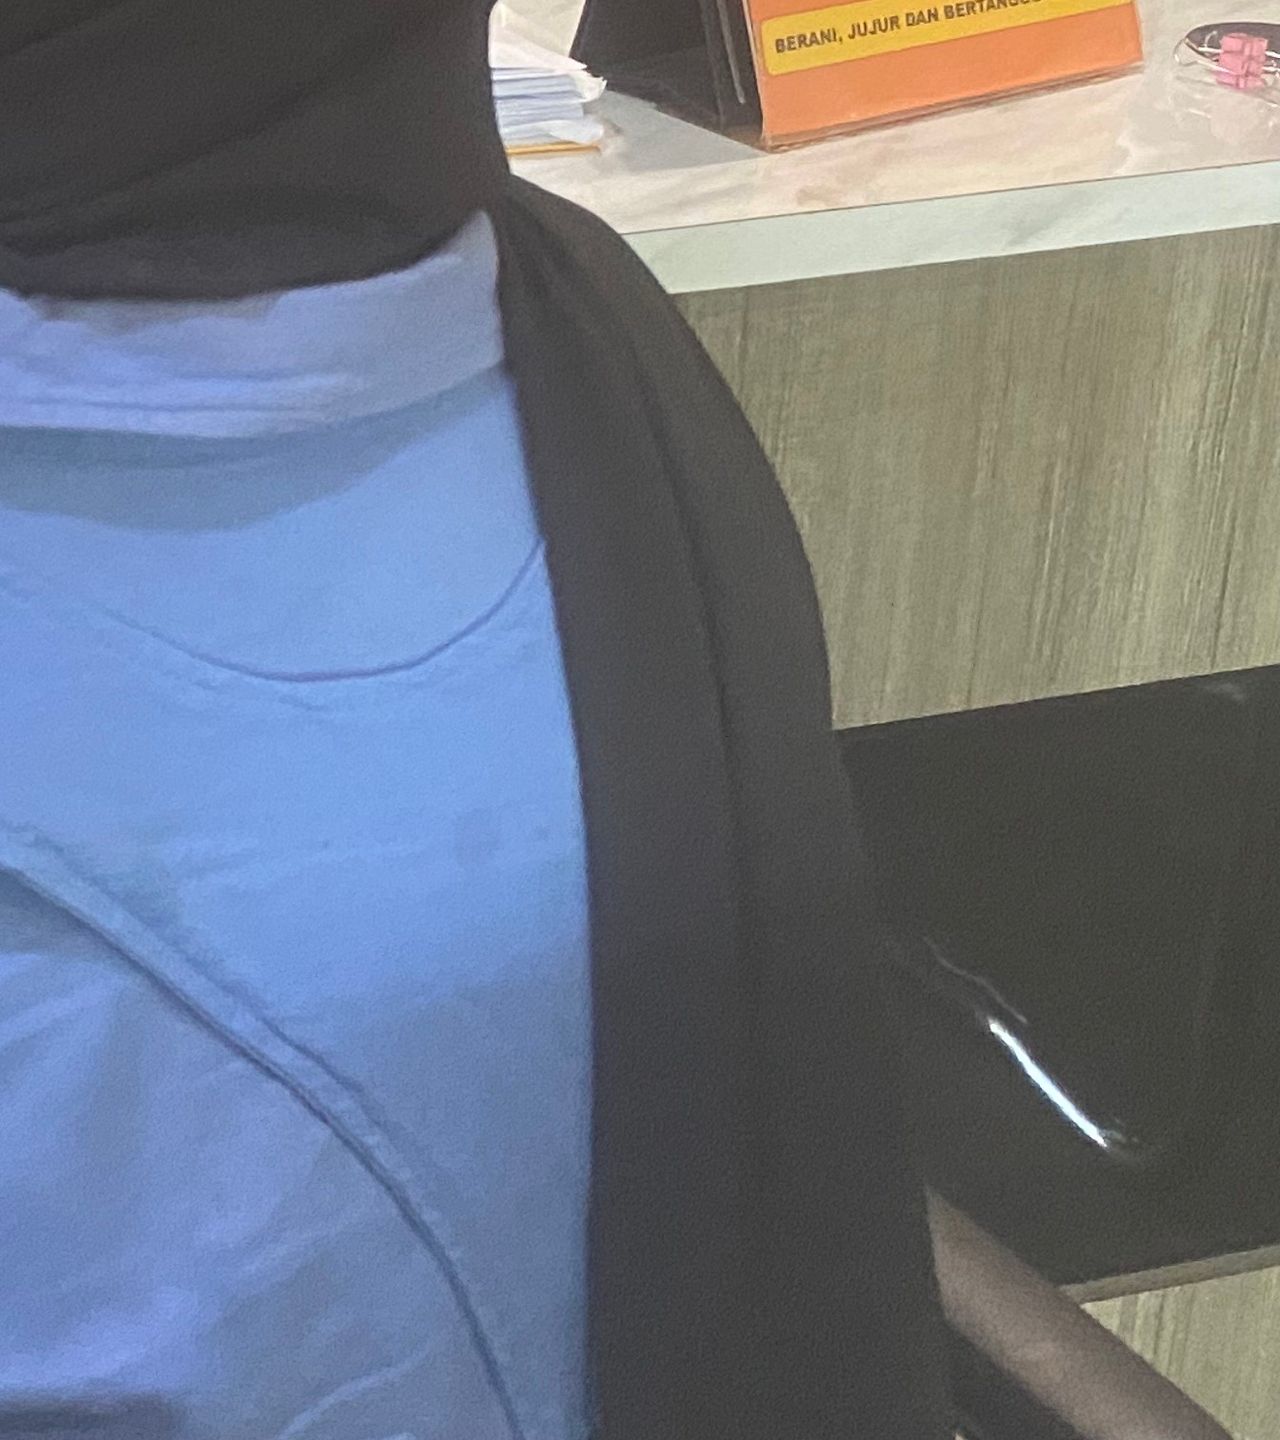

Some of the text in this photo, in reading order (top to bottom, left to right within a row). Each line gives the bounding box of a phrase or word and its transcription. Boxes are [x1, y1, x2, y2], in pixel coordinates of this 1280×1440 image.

[774, 27, 843, 54] BERANI,
[847, 15, 901, 41] JUJUR
[905, 7, 940, 27] DAN
